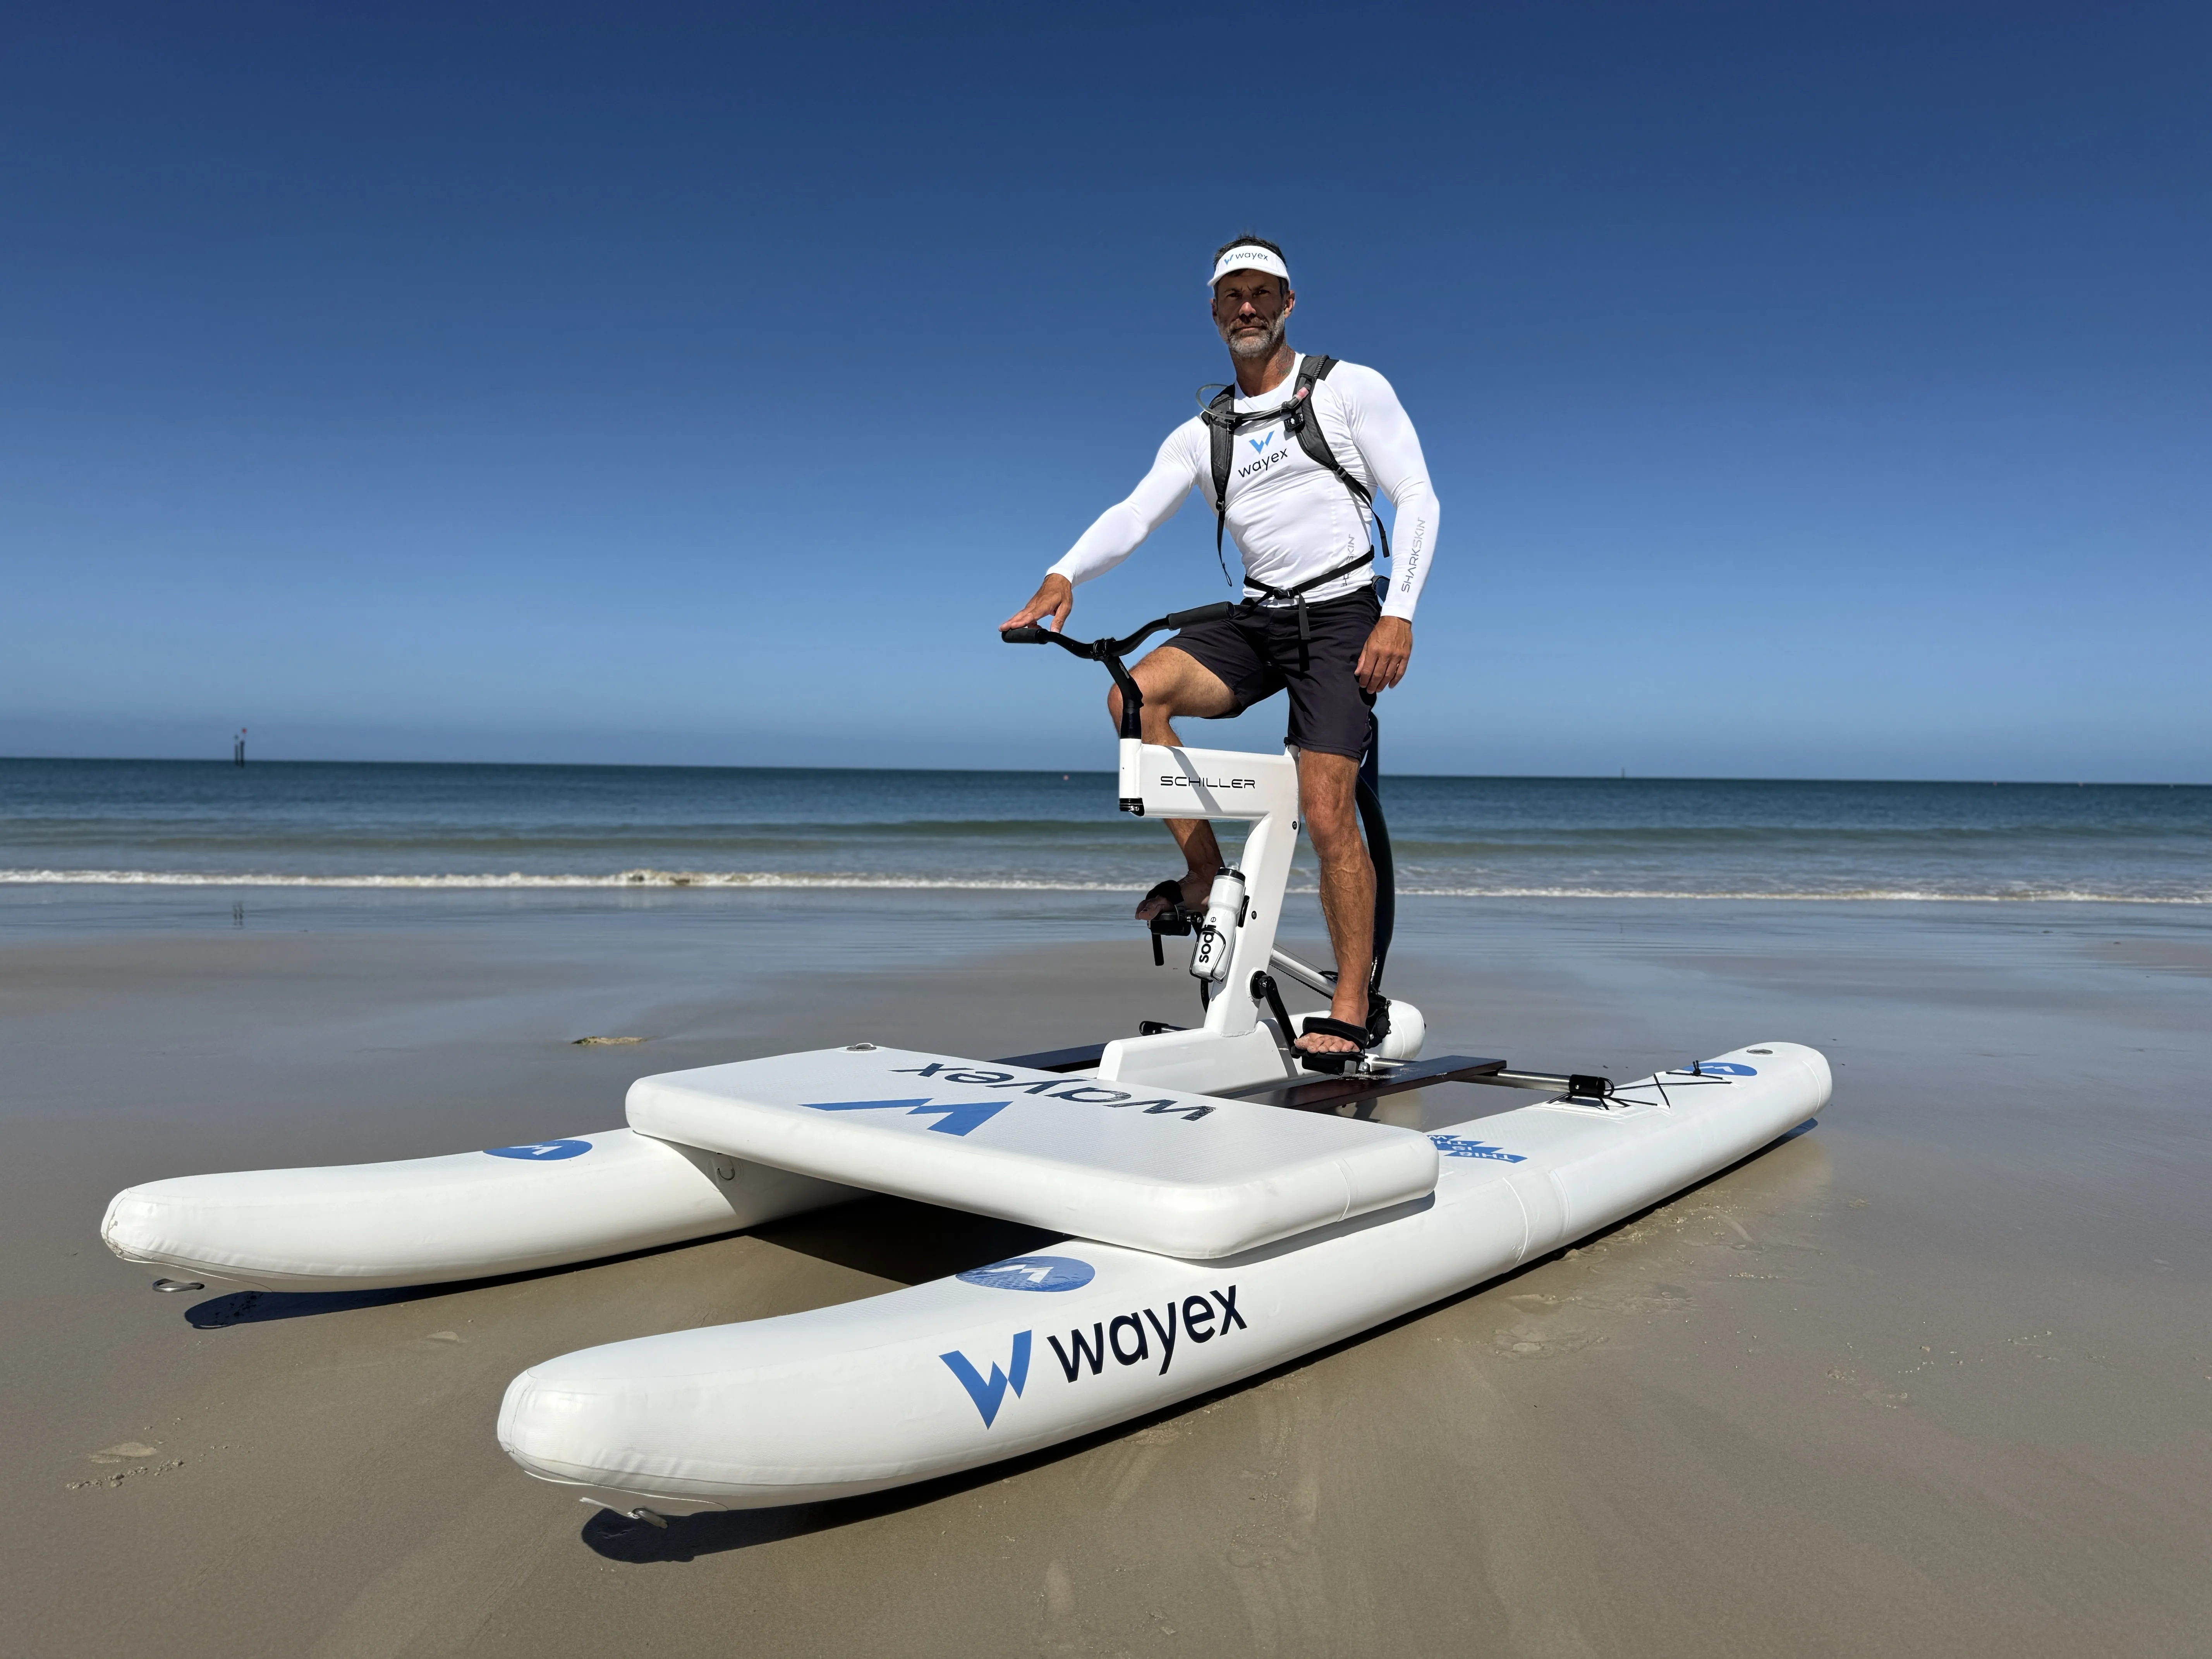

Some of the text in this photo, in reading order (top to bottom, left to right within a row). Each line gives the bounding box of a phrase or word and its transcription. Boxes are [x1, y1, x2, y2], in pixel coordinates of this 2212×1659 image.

[1235, 252, 1268, 261] wayex
[1238, 448, 1288, 477] wayex
[1401, 517, 1425, 592] SHARKSKIN
[1160, 776, 1255, 789] SCHILLER
[887, 1063, 1217, 1121] wayex
[1459, 1152, 1514, 1161] THIS
[1046, 1285, 1247, 1383] wayex
